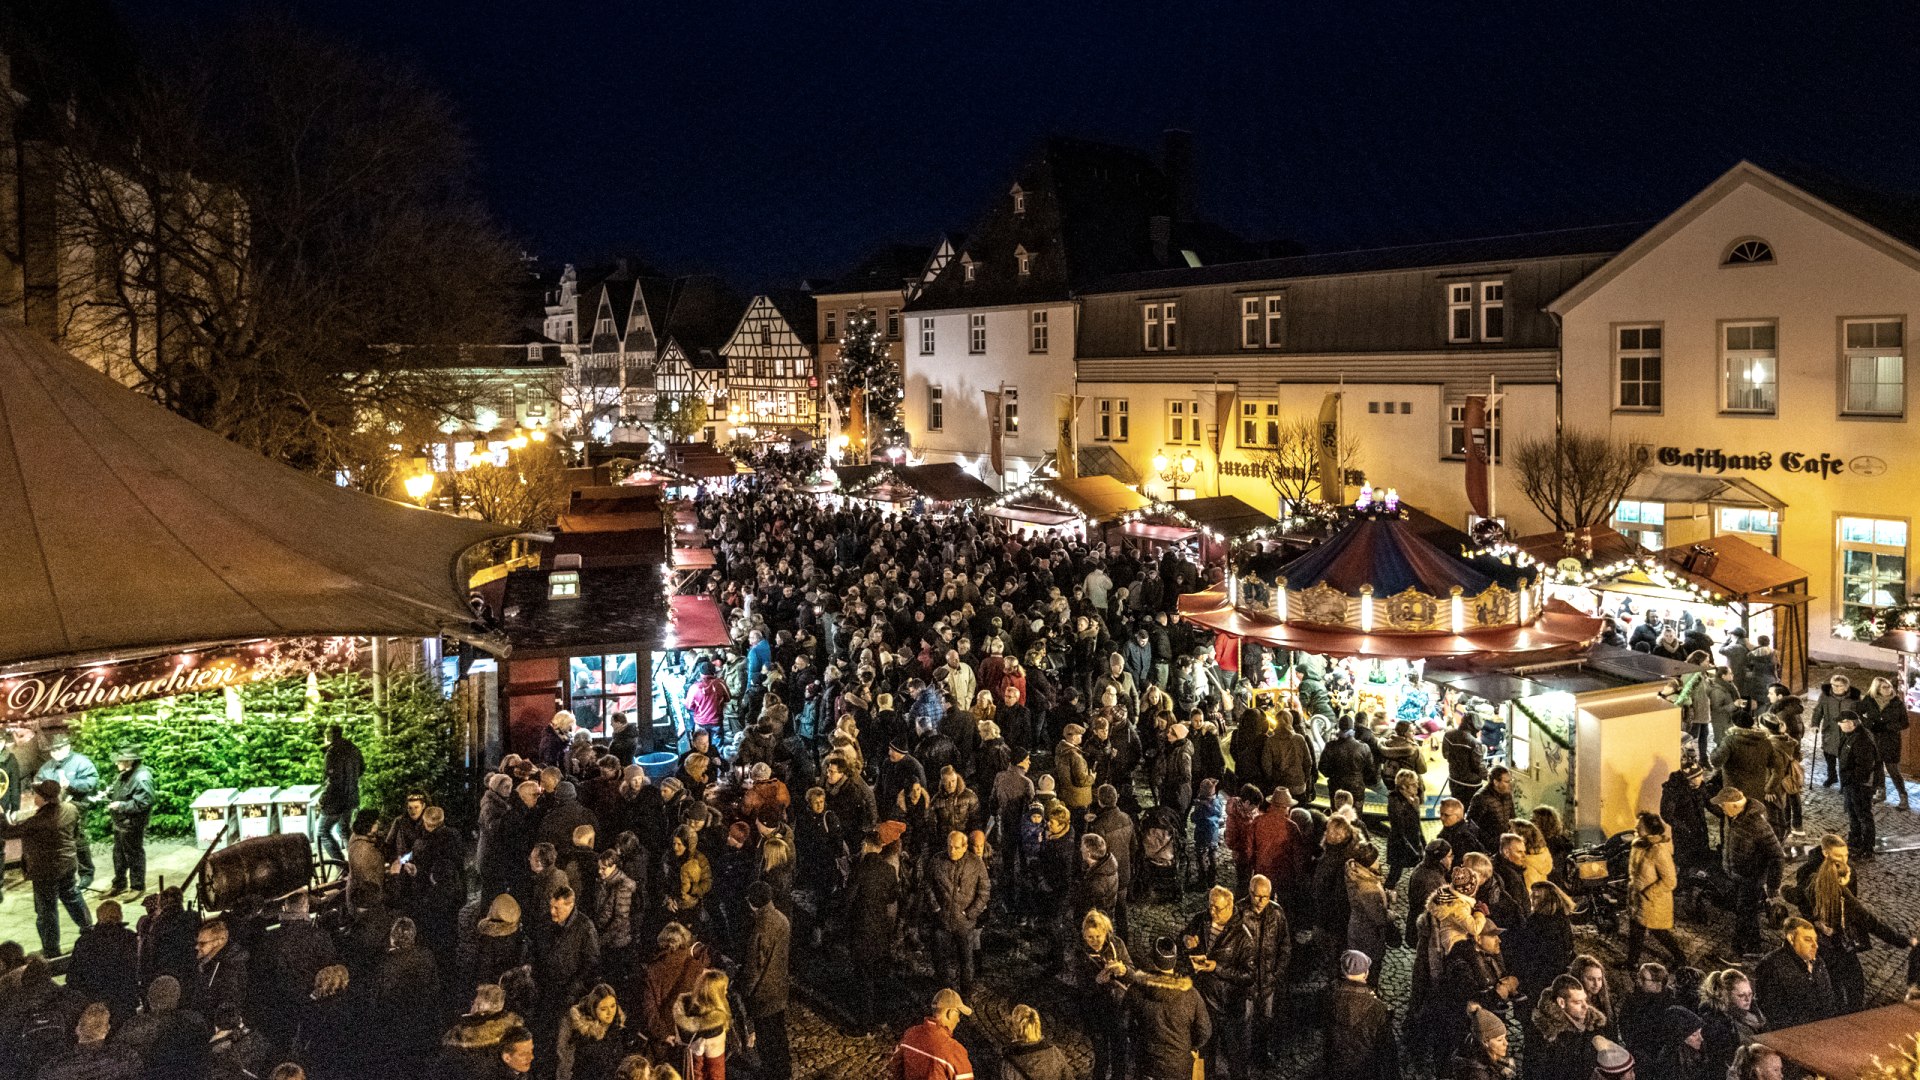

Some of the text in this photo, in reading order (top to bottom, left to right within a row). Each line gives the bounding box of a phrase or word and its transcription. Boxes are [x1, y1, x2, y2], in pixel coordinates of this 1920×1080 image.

[1656, 446, 1773, 474] Gasthaus
[1779, 451, 1844, 480] Cafe
[7, 663, 238, 715] Weihnachten
